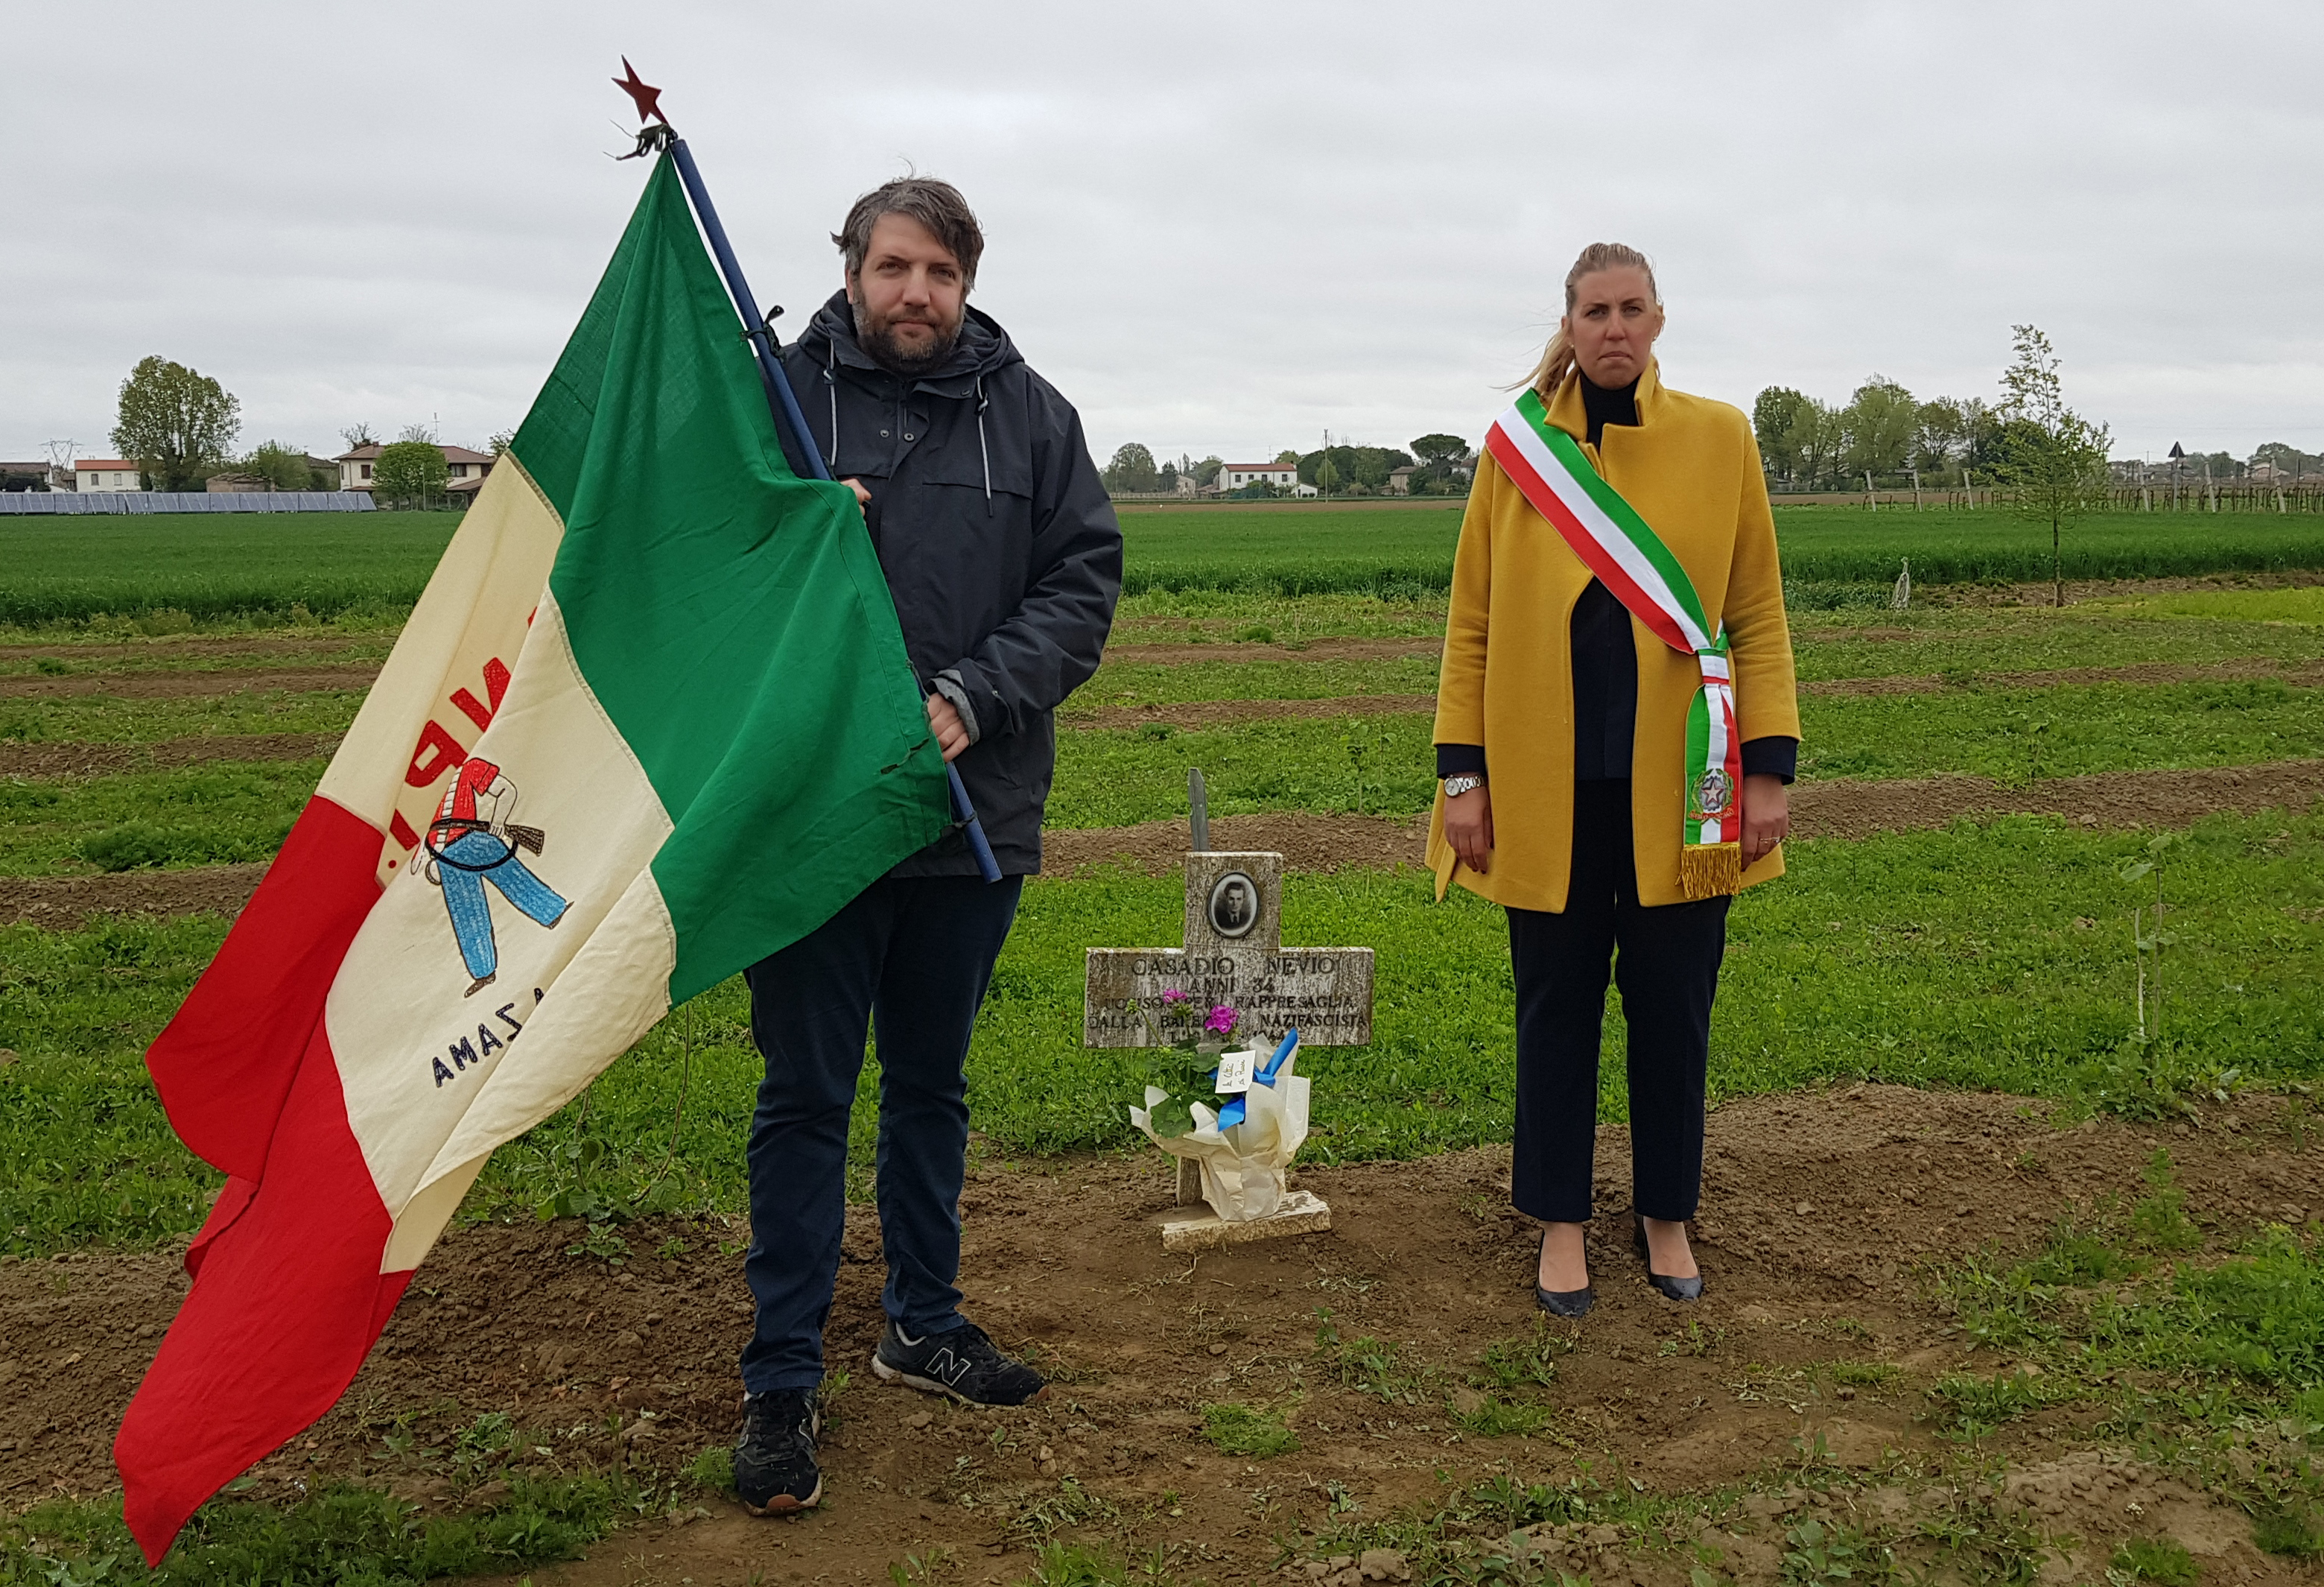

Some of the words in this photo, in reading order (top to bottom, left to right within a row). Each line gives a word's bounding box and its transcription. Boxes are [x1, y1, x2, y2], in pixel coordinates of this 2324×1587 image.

[1132, 957, 1234, 975] CASADIO
[1266, 957, 1335, 975] NEVIO
[1189, 978, 1235, 993] ANNI
[1088, 1016, 1142, 1028] DALLA
[1260, 1014, 1367, 1027] NAZIFASCISTA
[925, 1347, 971, 1387] N
